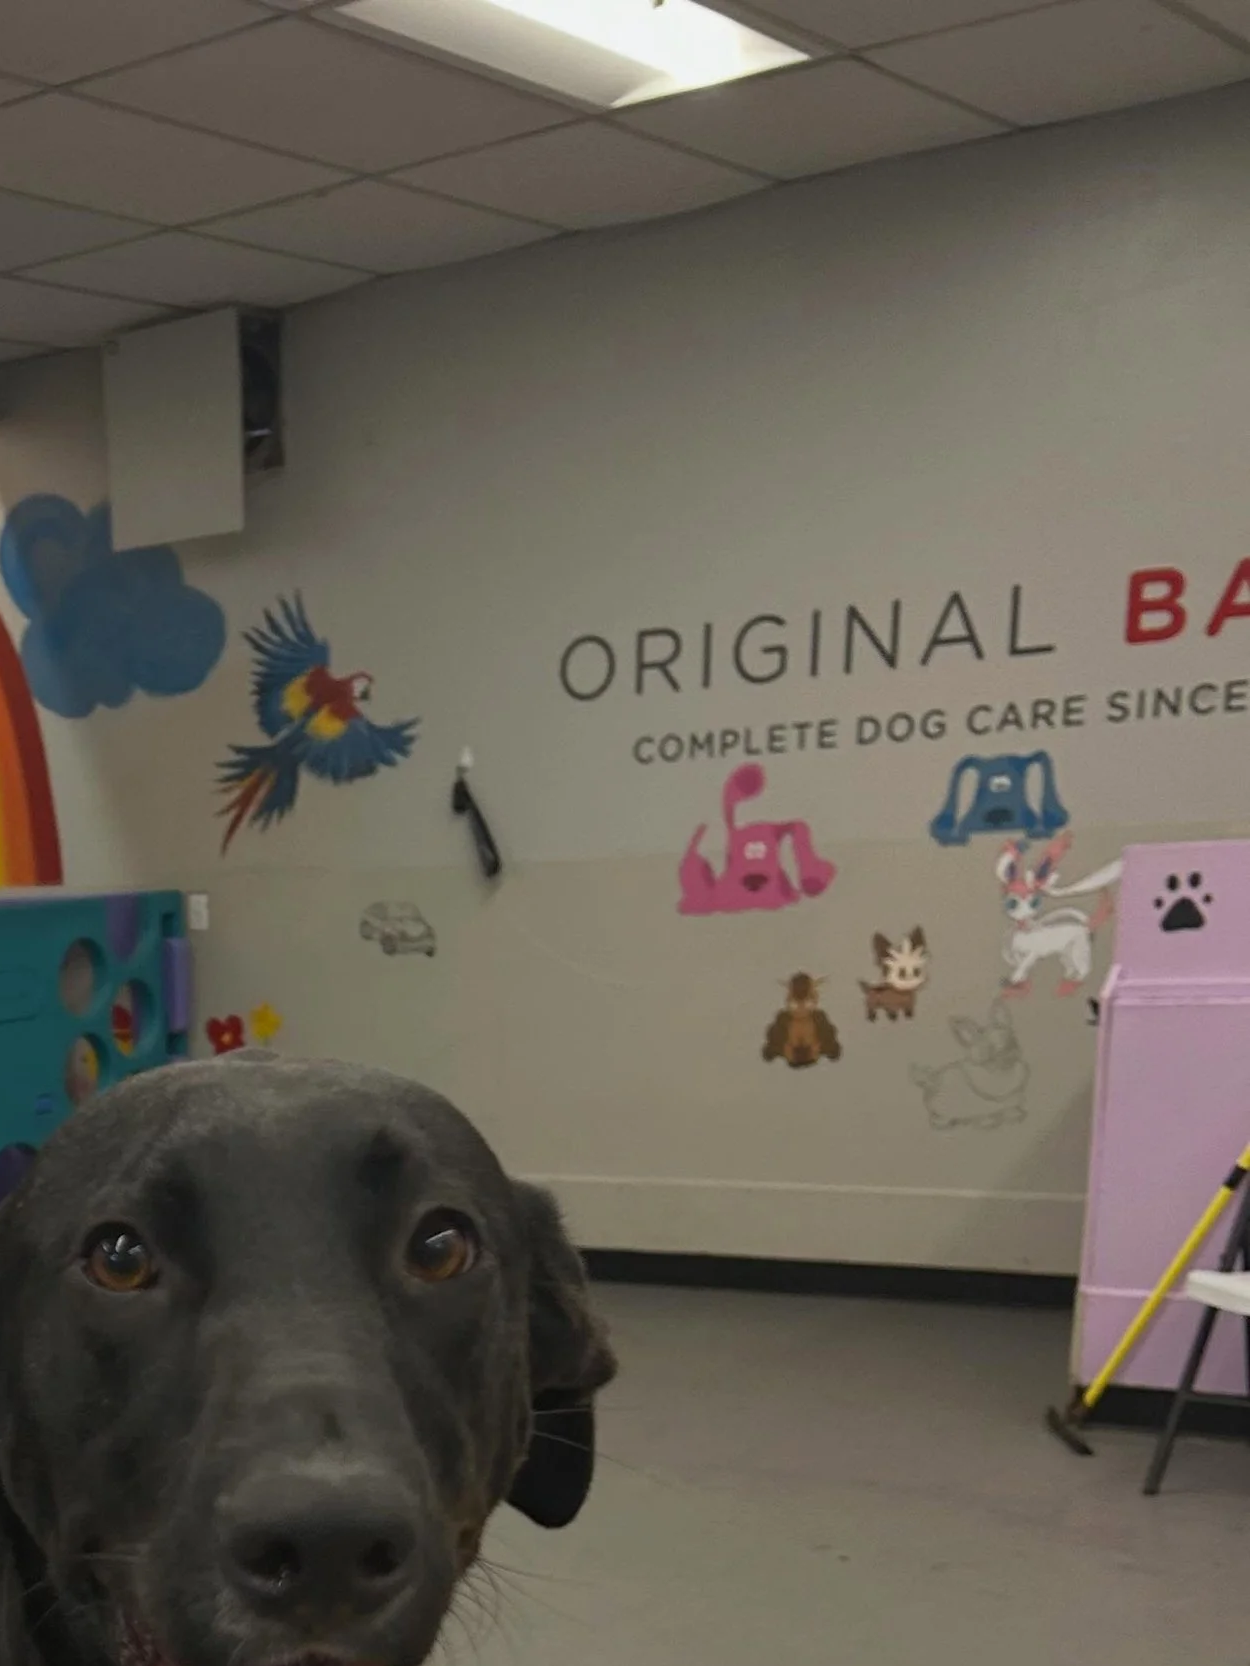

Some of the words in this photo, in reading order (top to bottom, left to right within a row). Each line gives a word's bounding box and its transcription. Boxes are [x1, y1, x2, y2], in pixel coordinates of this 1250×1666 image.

[558, 583, 1058, 702] ORIGINAL
[633, 718, 839, 765] COMPLETE
[855, 708, 948, 746] DOG
[966, 694, 1088, 737] CARE
[1105, 678, 1250, 724] SINCE
